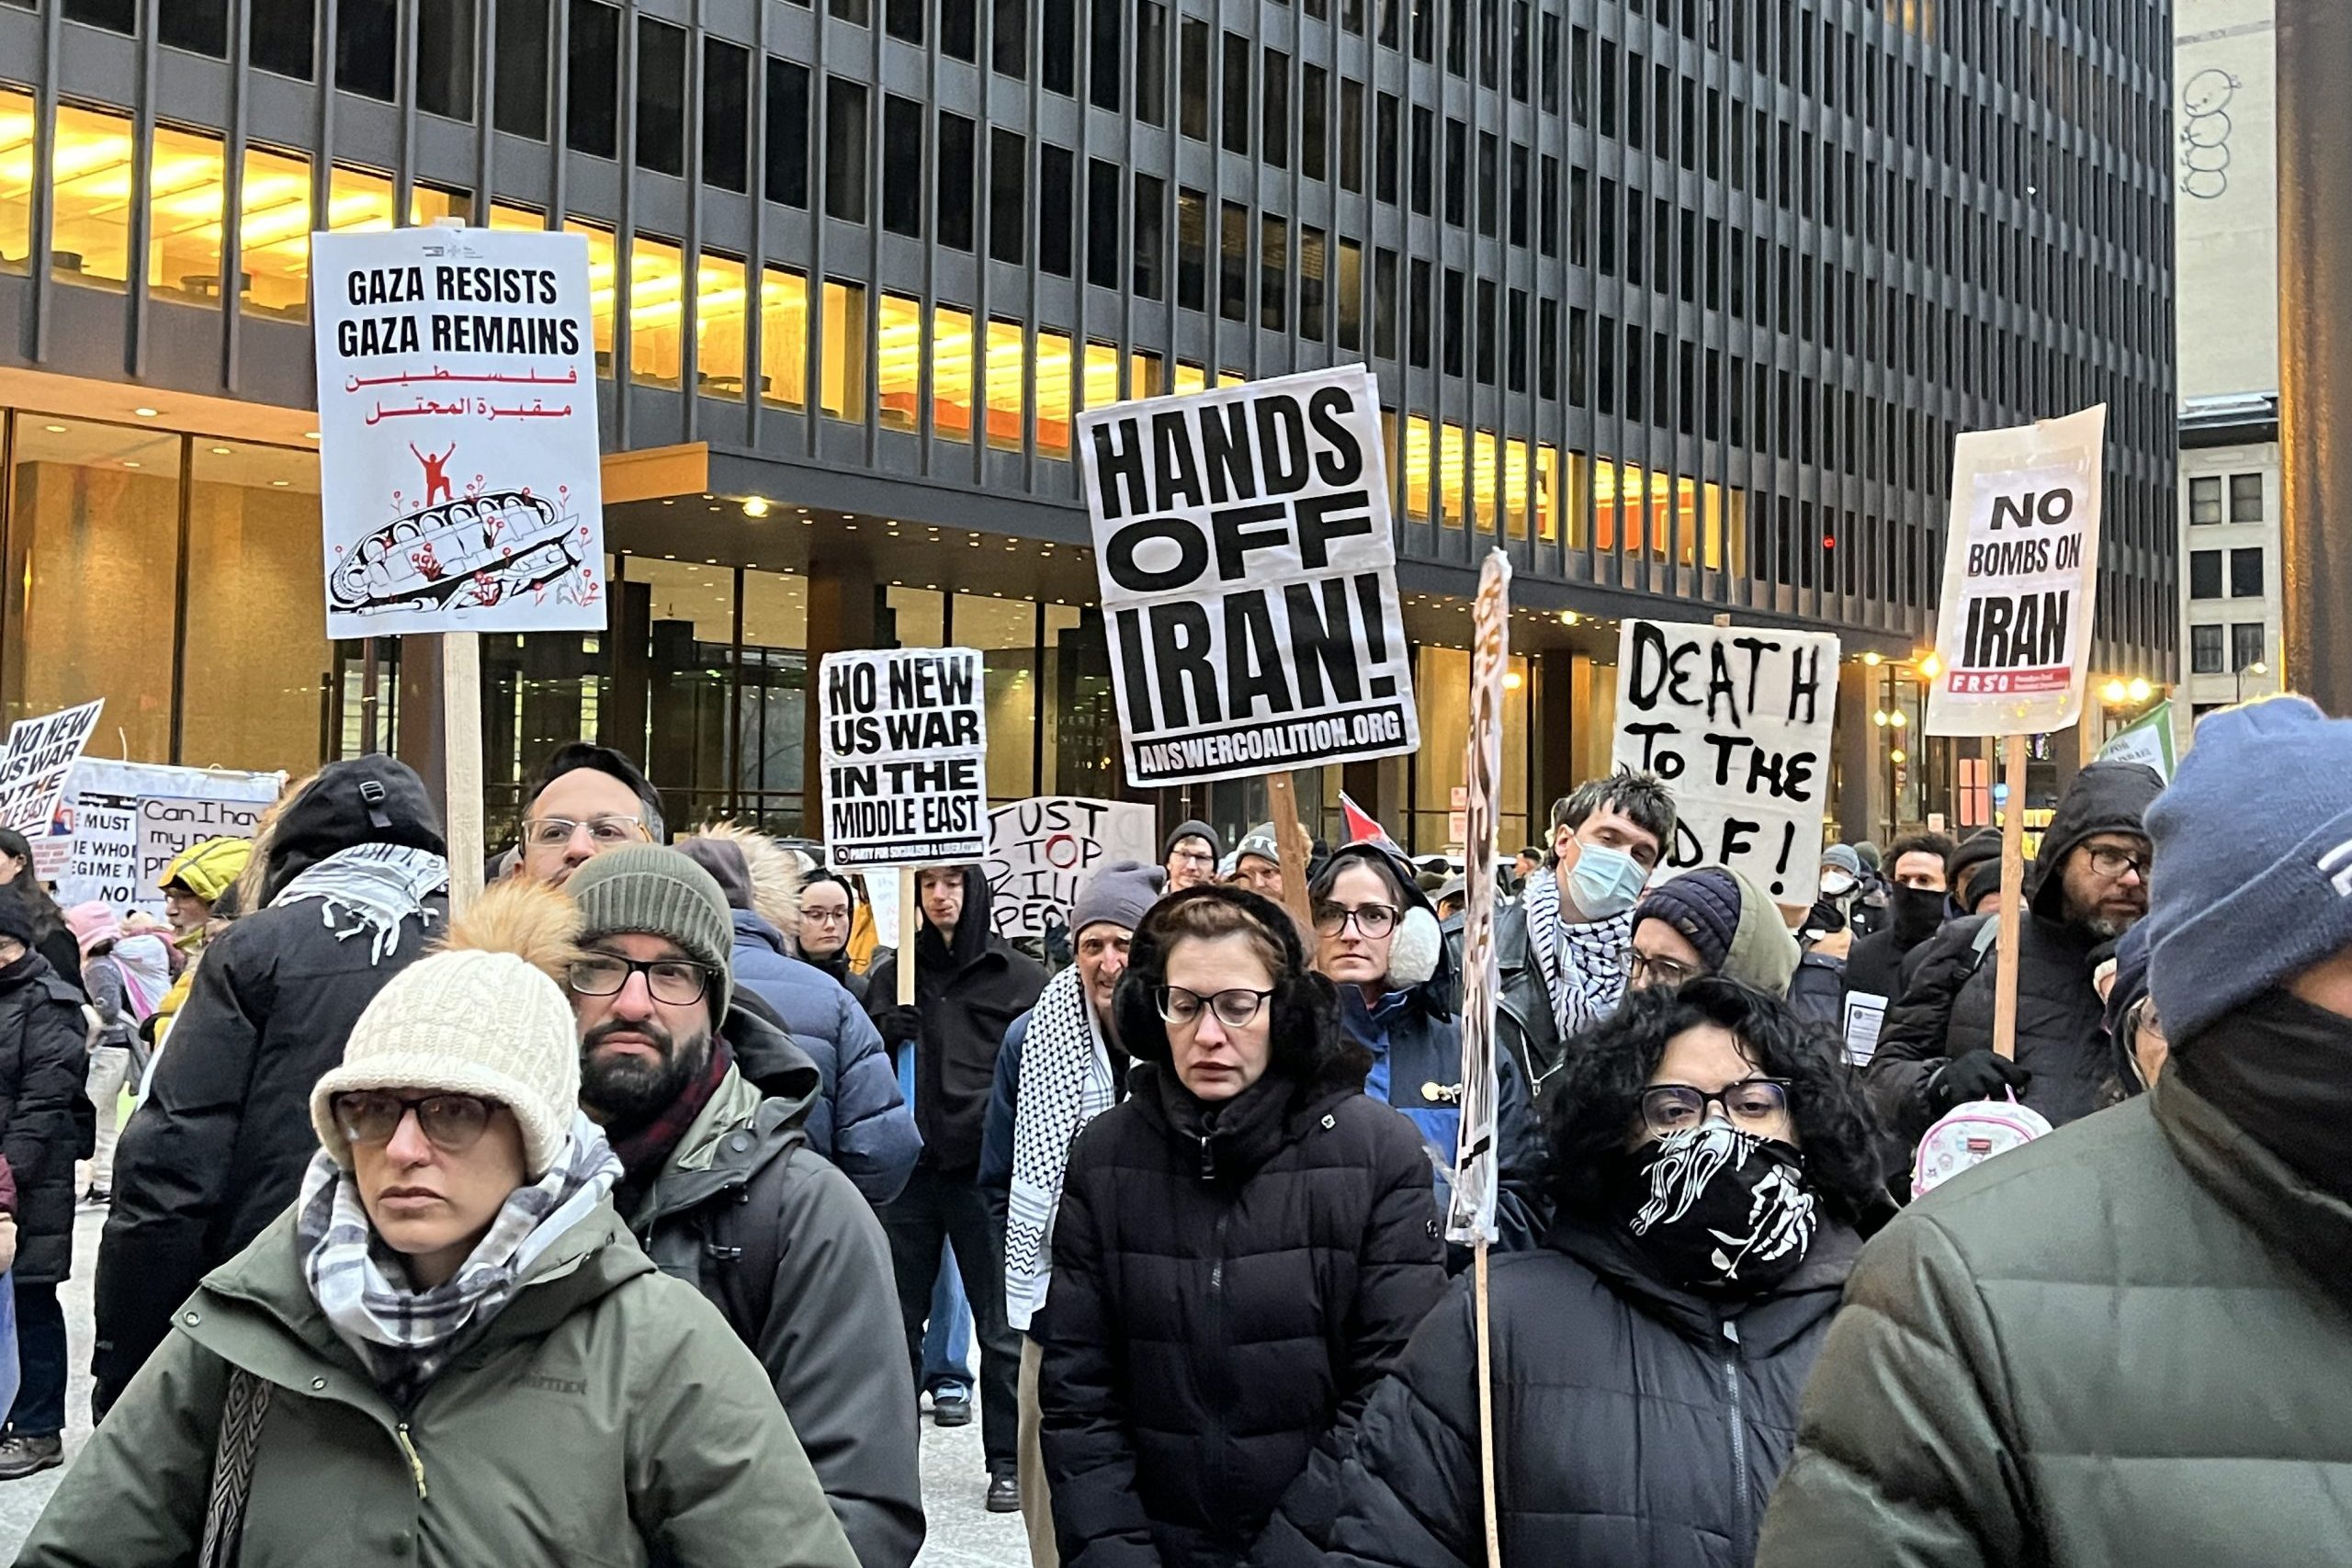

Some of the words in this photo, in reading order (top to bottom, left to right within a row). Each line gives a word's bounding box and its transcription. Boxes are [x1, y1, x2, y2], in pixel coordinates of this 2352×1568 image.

[348, 266, 424, 306] GAZA
[436, 265, 558, 305] RESISTS
[338, 315, 419, 357] GAZA
[432, 314, 580, 355] REMAINS
[365, 396, 471, 425] المحتل
[477, 397, 572, 422] مقبرة
[1092, 386, 1363, 520] HANDS
[1989, 488, 2074, 531] NO
[1105, 490, 1373, 592] OFF
[1967, 536, 2051, 578] BOMBS
[2055, 533, 2083, 571] ON
[1962, 590, 2070, 669] IRAN
[1115, 572, 1397, 735] IRAN!
[1628, 621, 1820, 728] DEATH
[829, 661, 876, 716] NO
[889, 655, 974, 709] NEW
[7, 722, 44, 760] NO
[40, 704, 99, 749] NEW
[831, 716, 881, 756] US
[885, 709, 980, 751] WAR
[1139, 710, 1401, 773] ANSWERCOALITION.ORG
[0, 756, 28, 785] US
[28, 739, 80, 776] WAR
[17, 769, 67, 799] THE
[831, 764, 877, 799] IN
[883, 758, 978, 795] THE
[1703, 732, 1817, 803] THE
[85, 813, 130, 831] MUST
[198, 801, 215, 824] I
[220, 803, 263, 826] hav
[832, 799, 917, 840] MIDDLE
[923, 795, 979, 834] EAST
[988, 800, 1109, 846] JUST
[151, 829, 186, 853] my
[1667, 816, 1796, 896] DF!
